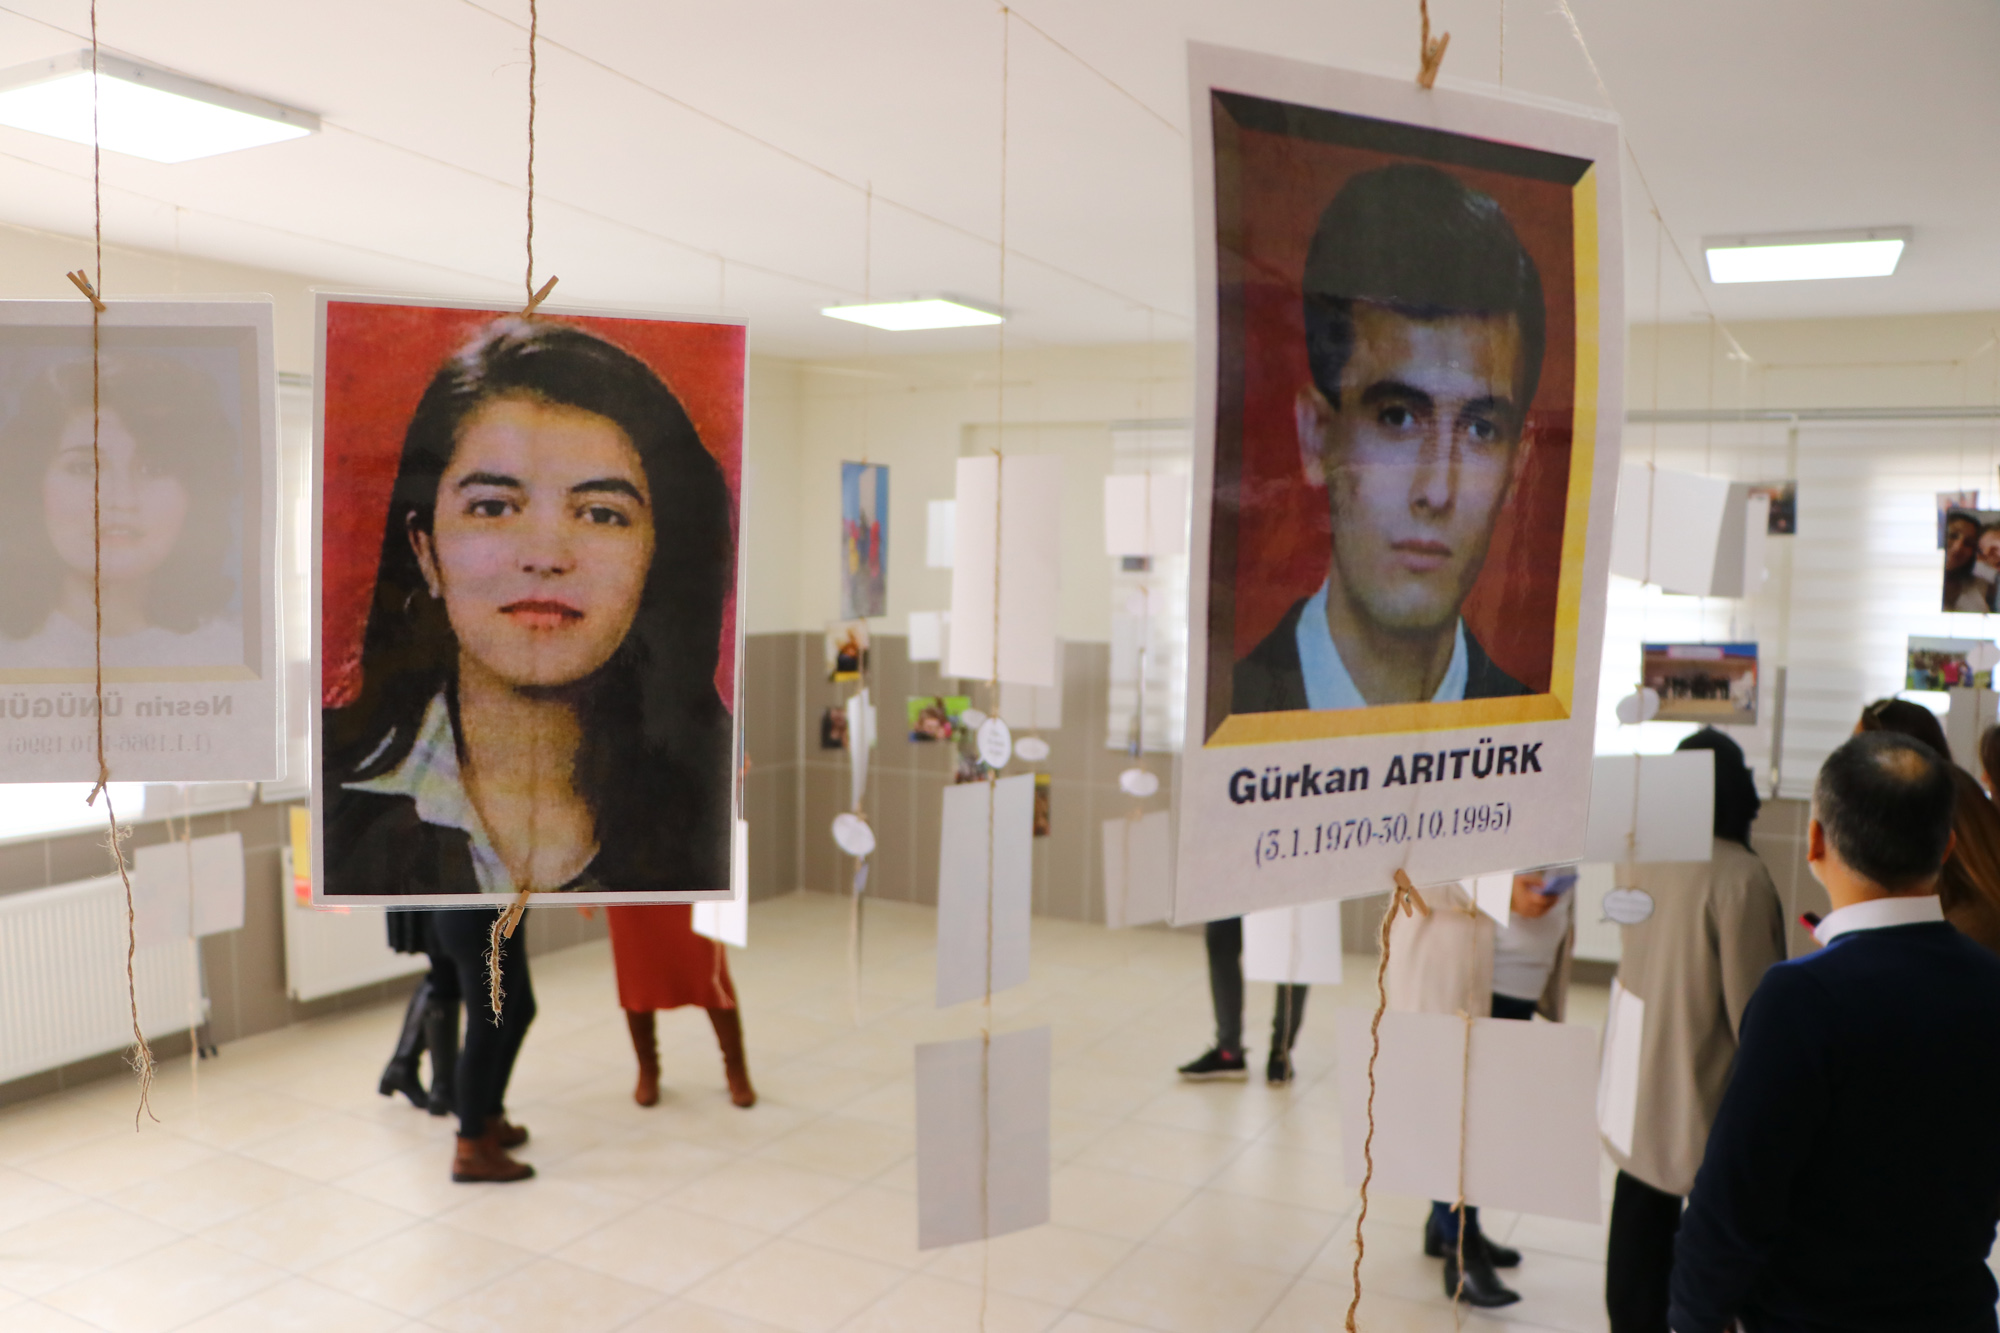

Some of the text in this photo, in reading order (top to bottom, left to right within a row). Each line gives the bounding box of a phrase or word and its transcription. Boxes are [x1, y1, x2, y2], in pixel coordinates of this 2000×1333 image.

[1228, 737, 1544, 804] Gürkan ARITÜRK
[1255, 801, 1513, 869] (3.1.1970-30.10.1995)
